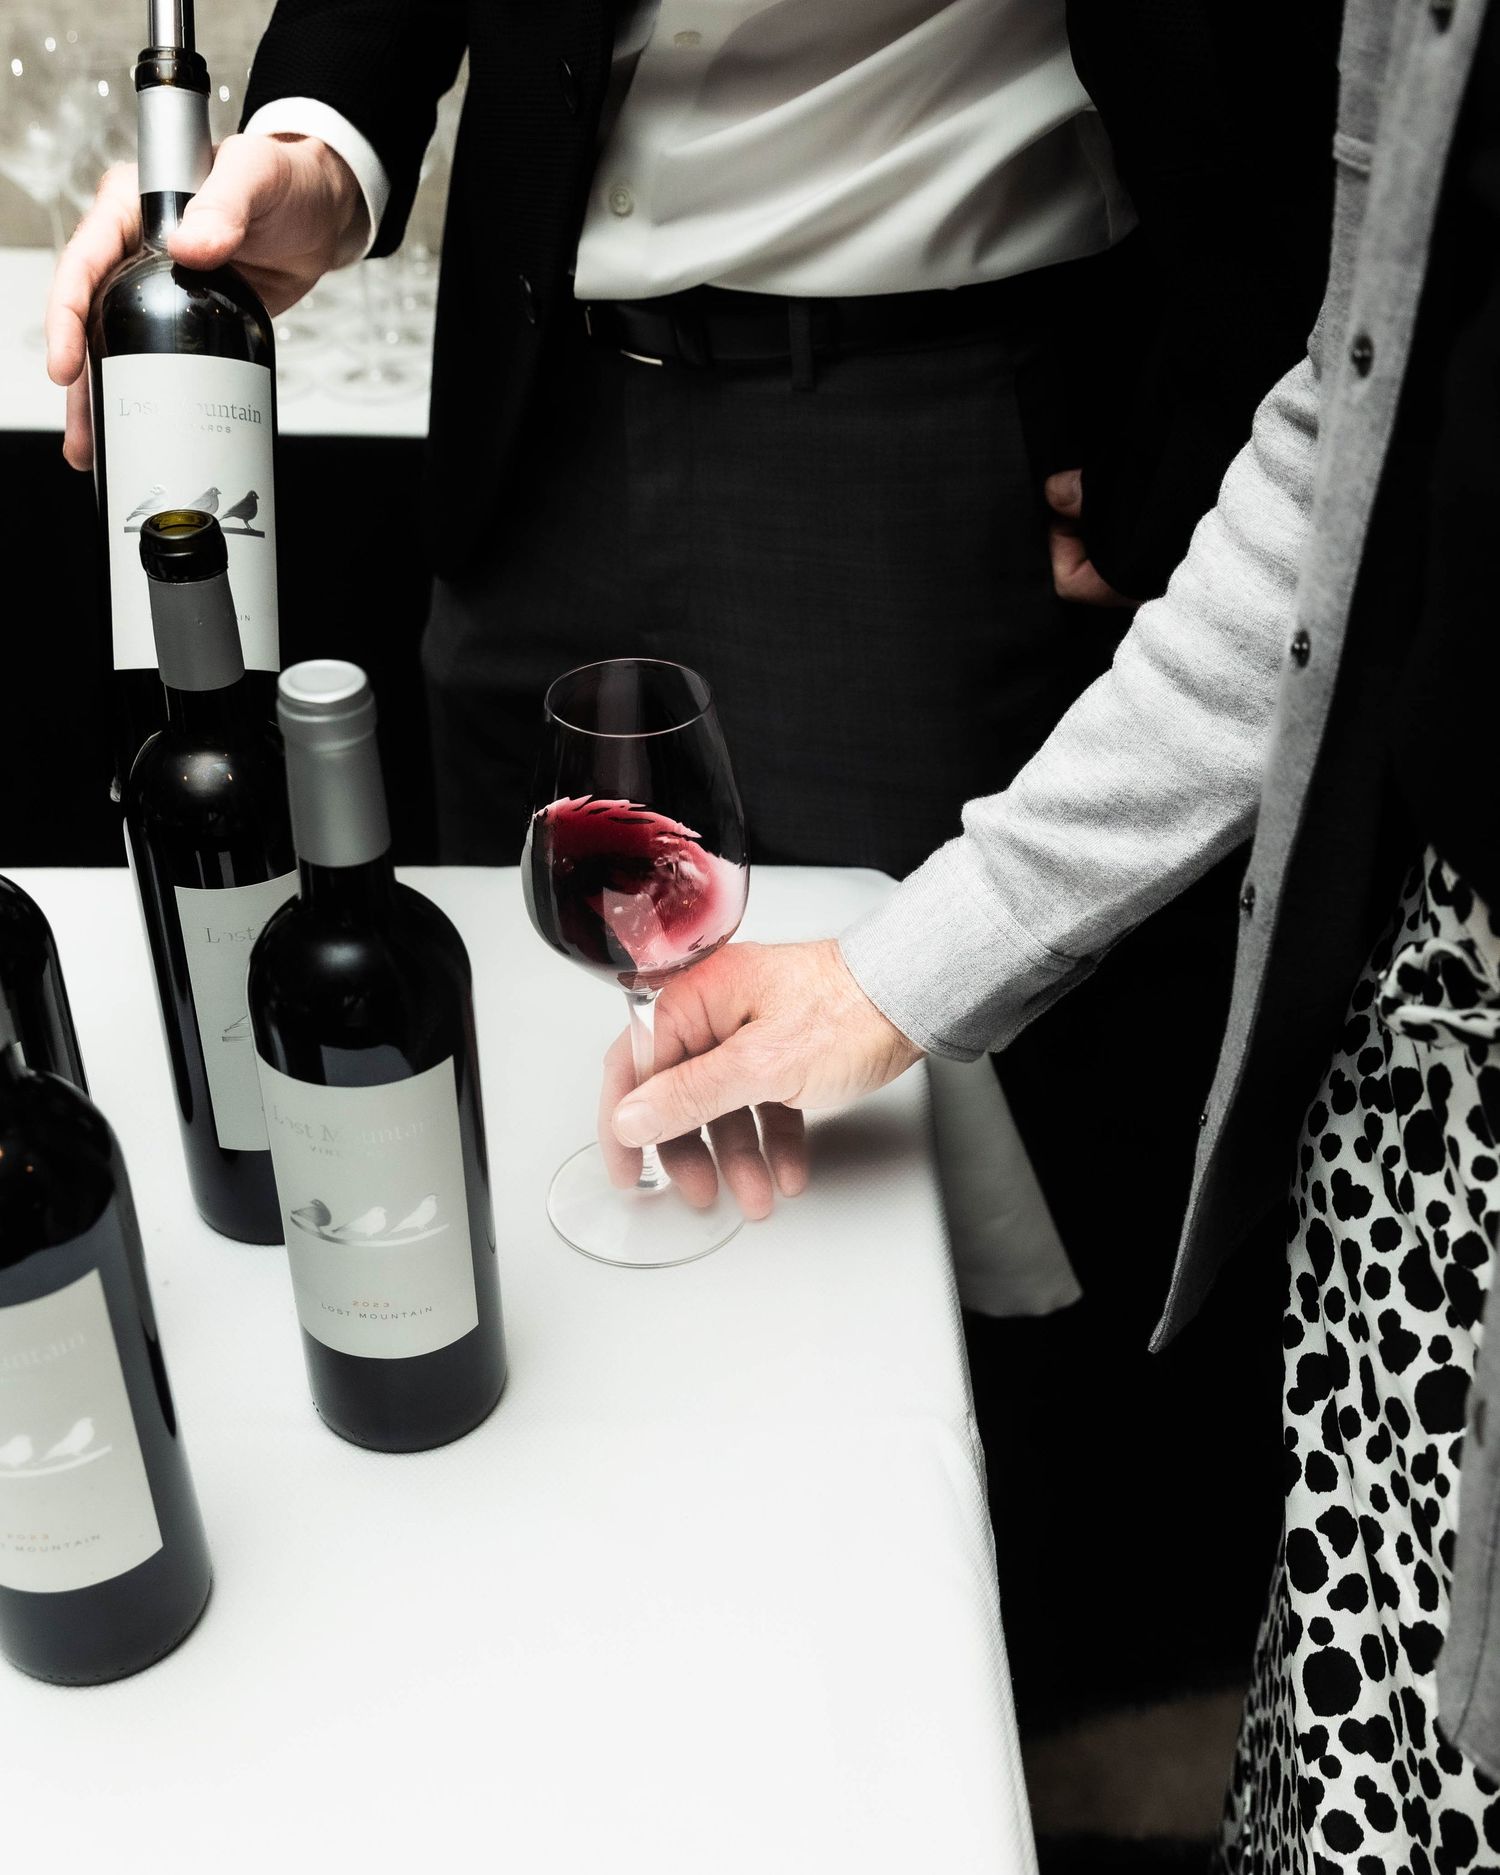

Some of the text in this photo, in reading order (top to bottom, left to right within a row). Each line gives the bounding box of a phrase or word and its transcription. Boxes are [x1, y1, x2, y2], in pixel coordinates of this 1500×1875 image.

[119, 398, 262, 424] Los ountain
[204, 926, 257, 943] Lost
[321, 1303, 432, 1320] LOST MOUNTAIN
[352, 1300, 390, 1309] 2023
